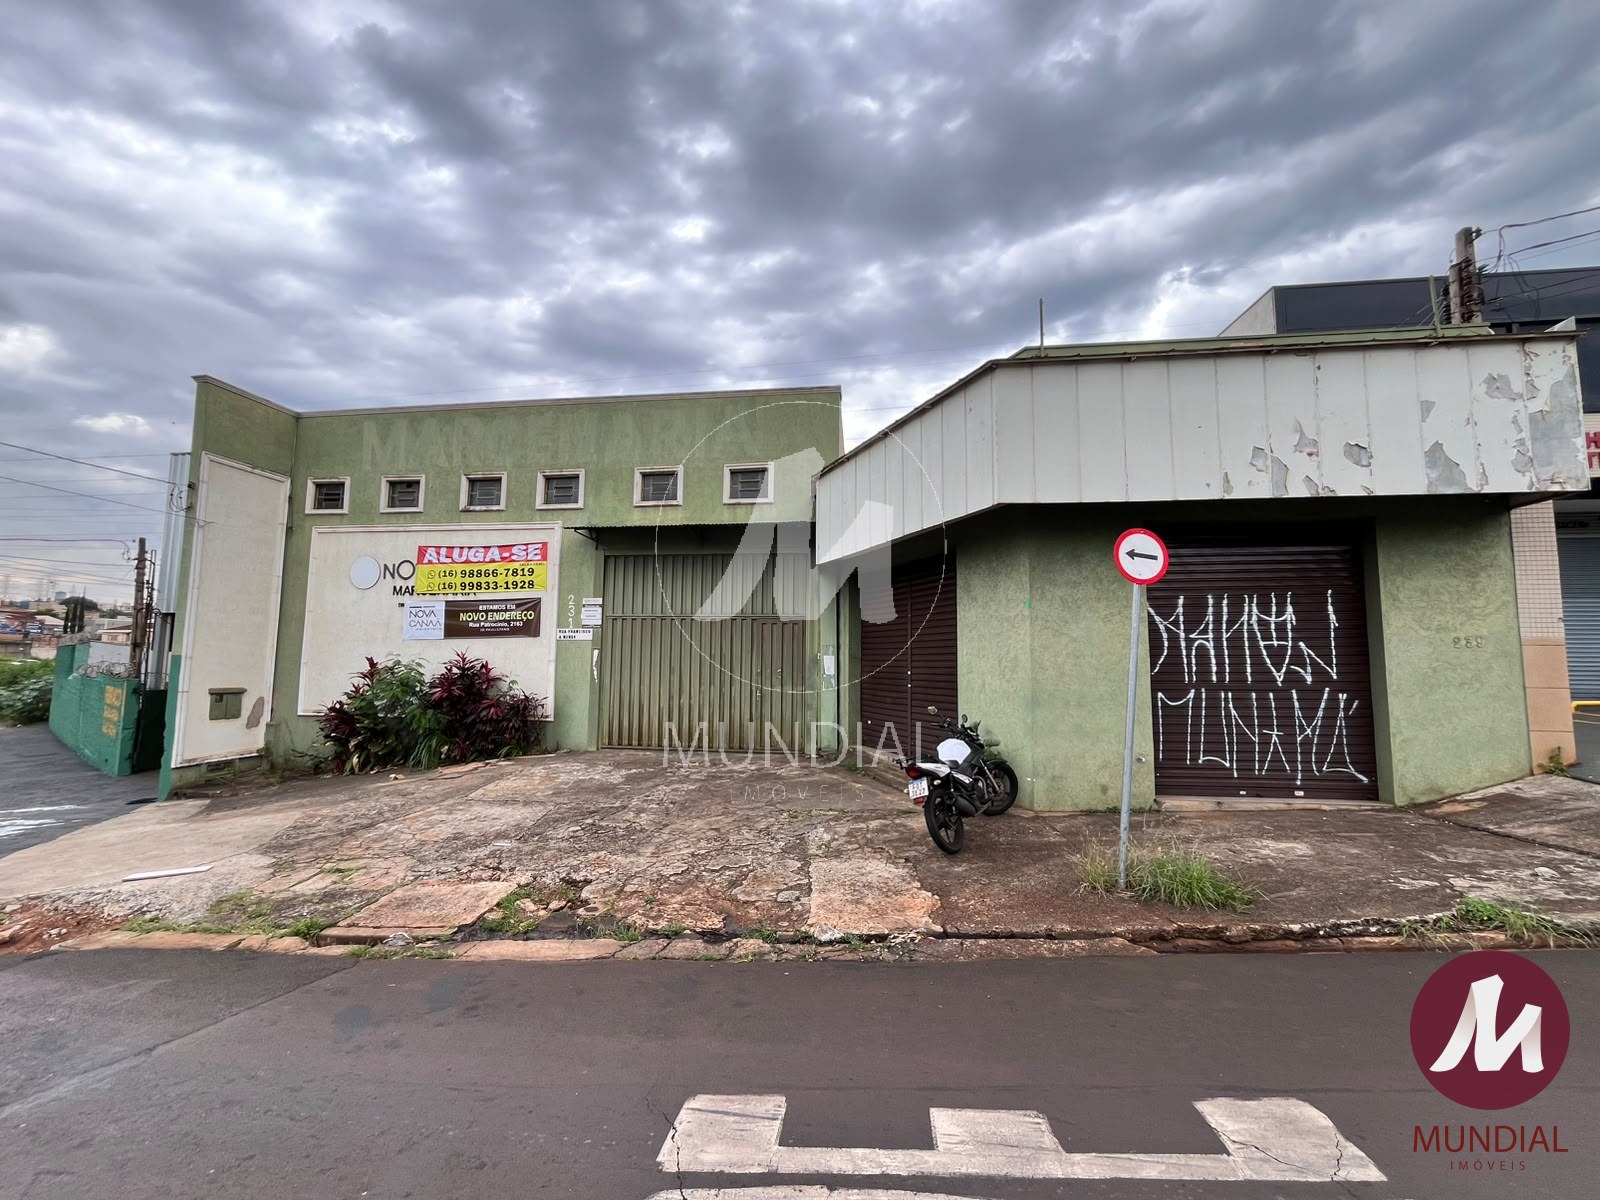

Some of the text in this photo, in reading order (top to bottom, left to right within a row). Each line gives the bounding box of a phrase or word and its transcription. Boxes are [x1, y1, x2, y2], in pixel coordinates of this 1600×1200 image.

[422, 543, 543, 564] ALUGA-SE
[383, 560, 415, 580] NO
[438, 567, 535, 579] (16) 98866-7819
[438, 582, 457, 591] (16)
[460, 580, 535, 591] 99833-1928
[409, 609, 437, 618] NOVA
[459, 610, 535, 623] NOVO ENDEREÇO
